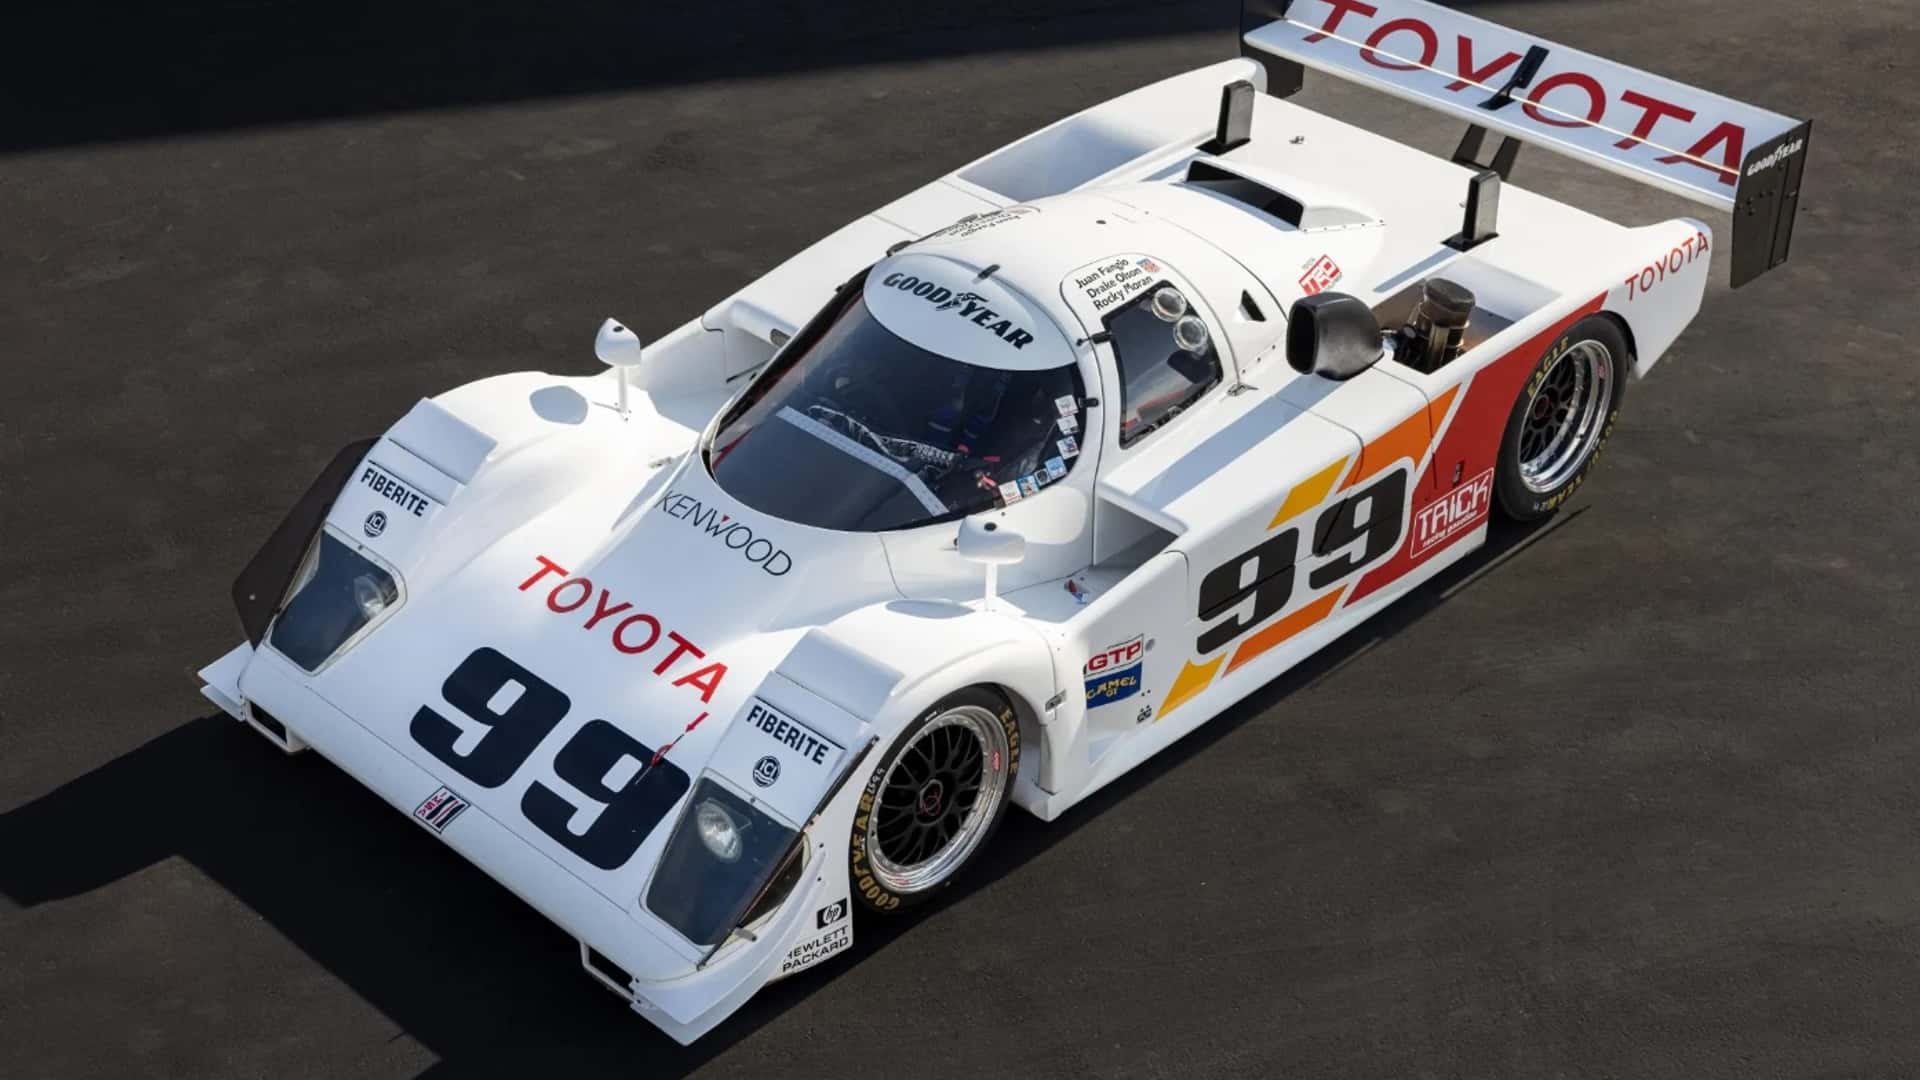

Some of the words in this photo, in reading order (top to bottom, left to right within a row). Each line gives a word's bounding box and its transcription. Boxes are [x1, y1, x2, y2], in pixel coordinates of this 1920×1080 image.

[1302, 0, 1746, 186] TOYOTA
[1747, 139, 1803, 176] GOODYEAR
[1075, 272, 1101, 289] Juan
[1097, 259, 1129, 276] Fangio
[1086, 280, 1117, 298] Drake
[1115, 267, 1142, 282] Olson
[1093, 289, 1125, 310] Rocky
[1123, 276, 1153, 293] Moran
[1625, 231, 1709, 301] TOYOTA
[883, 273, 1034, 350] GOODYEAR
[360, 467, 429, 518] FIBERITE
[655, 489, 793, 576] KENWOOD
[1197, 467, 1408, 655] 99
[518, 555, 729, 704] TOYOTA
[1088, 639, 1141, 671] GTP
[1086, 676, 1136, 699] CAMEL
[409, 646, 691, 871] 99
[746, 704, 829, 766] FIBERITE
[1000, 709, 1021, 774] EAGLE
[853, 793, 900, 911] GOODYEAR
[783, 936, 849, 973] PACKARD
[786, 924, 848, 960] HEWLETT
